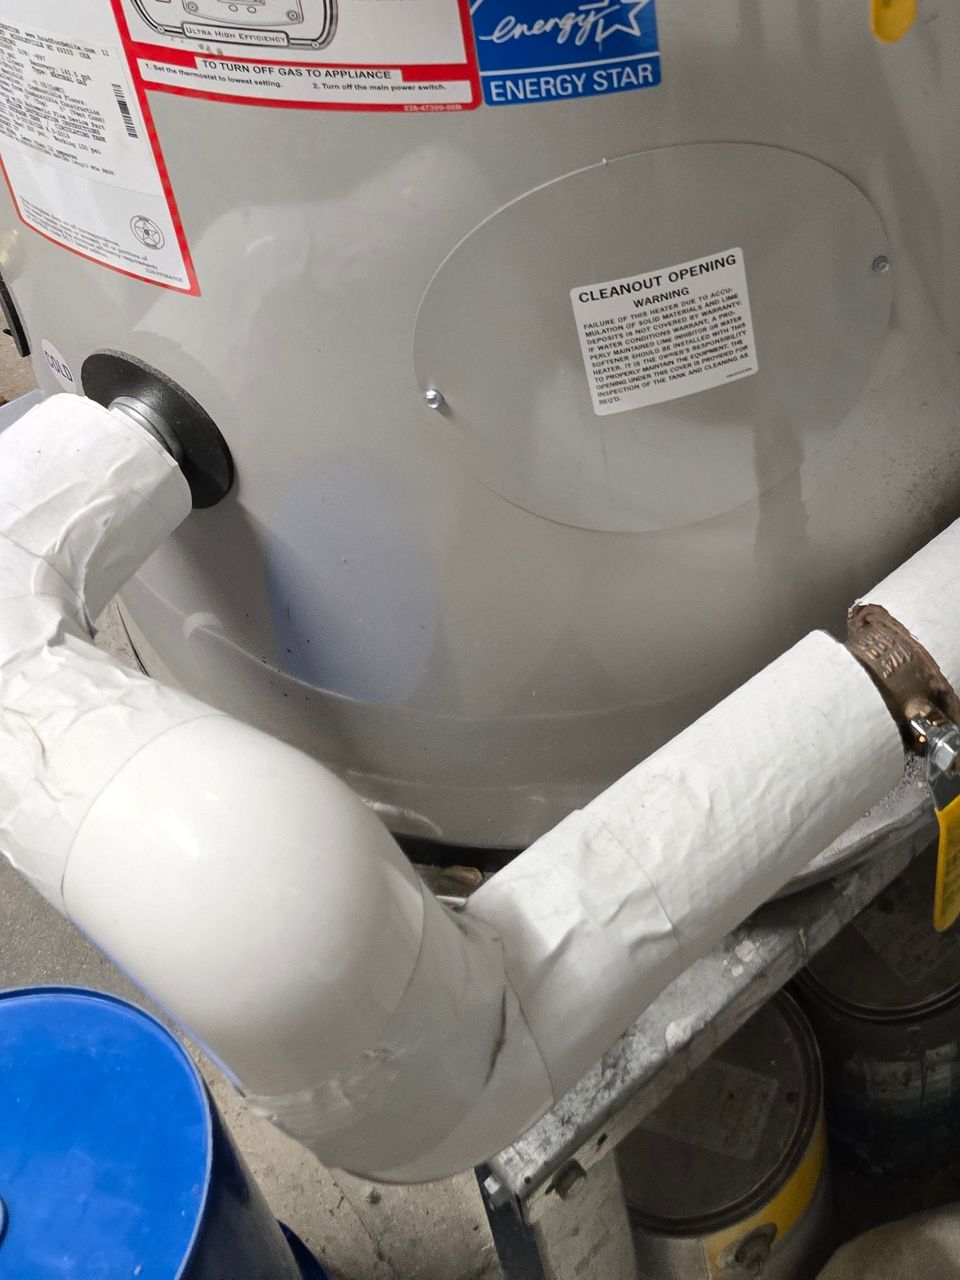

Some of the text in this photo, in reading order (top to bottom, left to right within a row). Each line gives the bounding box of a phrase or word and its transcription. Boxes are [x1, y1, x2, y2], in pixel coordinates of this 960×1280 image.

[481, 6, 619, 46] energy
[153, 64, 165, 72] Set
[166, 66, 178, 75] the
[178, 68, 218, 82] thermostat
[218, 74, 227, 83] to
[227, 76, 253, 86] lowest
[202, 59, 392, 80] TO TURN OFF GAS TO APPLIANCE
[322, 82, 340, 90] Turn
[341, 82, 353, 90] off
[354, 83, 368, 91] the
[390, 84, 416, 93] power
[490, 63, 654, 102] ENERGY STAR
[578, 254, 736, 303] CLEANOUT OPENING
[633, 286, 689, 308] WARNING
[583, 318, 615, 329] FAILURE
[630, 311, 647, 319] THIS
[649, 303, 678, 314] HEATER
[681, 298, 696, 306] DUE
[585, 325, 623, 337] MULATION
[638, 316, 660, 325] SOLID
[662, 304, 702, 319] MATERIALS
[704, 299, 719, 308] AND
[721, 293, 738, 302] LIME
[586, 332, 623, 345] DEPOSITS
[635, 326, 650, 334] NOT
[652, 316, 687, 330] COVERED
[589, 351, 610, 360] PERLY
[613, 341, 654, 355] MAINTAINED
[656, 336, 671, 345] LIME
[720, 316, 741, 327] WATER
[591, 355, 629, 368] SOFTENER
[631, 347, 659, 359] SHOULD
[672, 334, 710, 348] INSTALLED
[712, 328, 729, 337] WITH
[731, 322, 745, 331] THIS
[597, 341, 622, 351] WATER
[625, 329, 670, 344] CONDITIONS
[643, 356, 656, 364] THE
[658, 347, 690, 360] OWNER'S
[692, 329, 746, 351] RESPONSIBILITY
[44, 350, 73, 382] COLD
[595, 378, 627, 390] OPENING
[628, 373, 651, 383] UNDER
[653, 368, 668, 377] THIS
[669, 362, 692, 372] COVER
[701, 349, 733, 363] PROVIDED
[735, 345, 748, 353] FOR
[597, 383, 639, 398] INSPECTION
[668, 371, 686, 380] TANK
[688, 366, 702, 375] AND
[704, 356, 737, 370] CLEANING
[605, 368, 641, 380] PROPERLY
[642, 359, 674, 372] MAINTAIN
[676, 355, 688, 363] THE
[730, 339, 743, 347] THE
